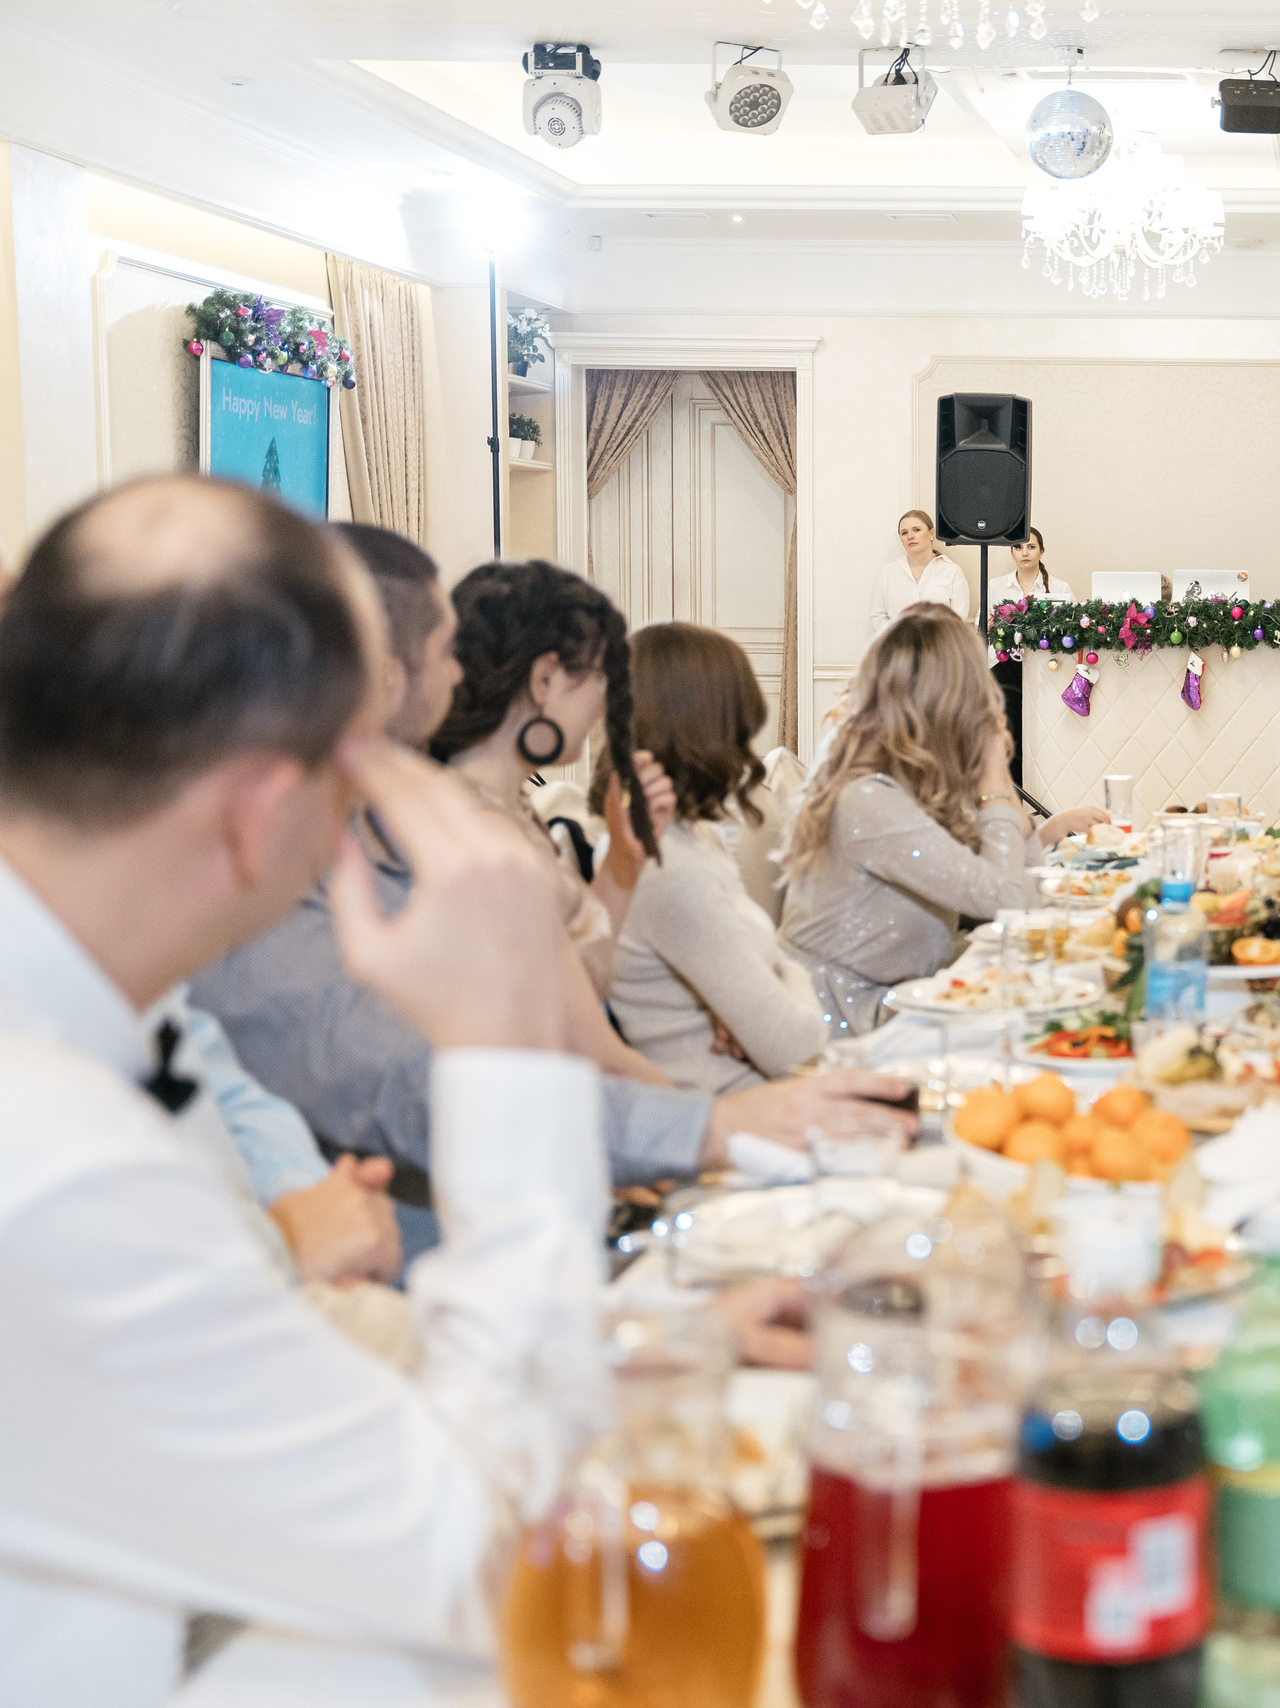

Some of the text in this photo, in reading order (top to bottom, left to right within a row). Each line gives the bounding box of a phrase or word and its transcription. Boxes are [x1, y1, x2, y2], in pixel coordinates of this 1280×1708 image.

[222, 387, 317, 425] Happy New Year!
